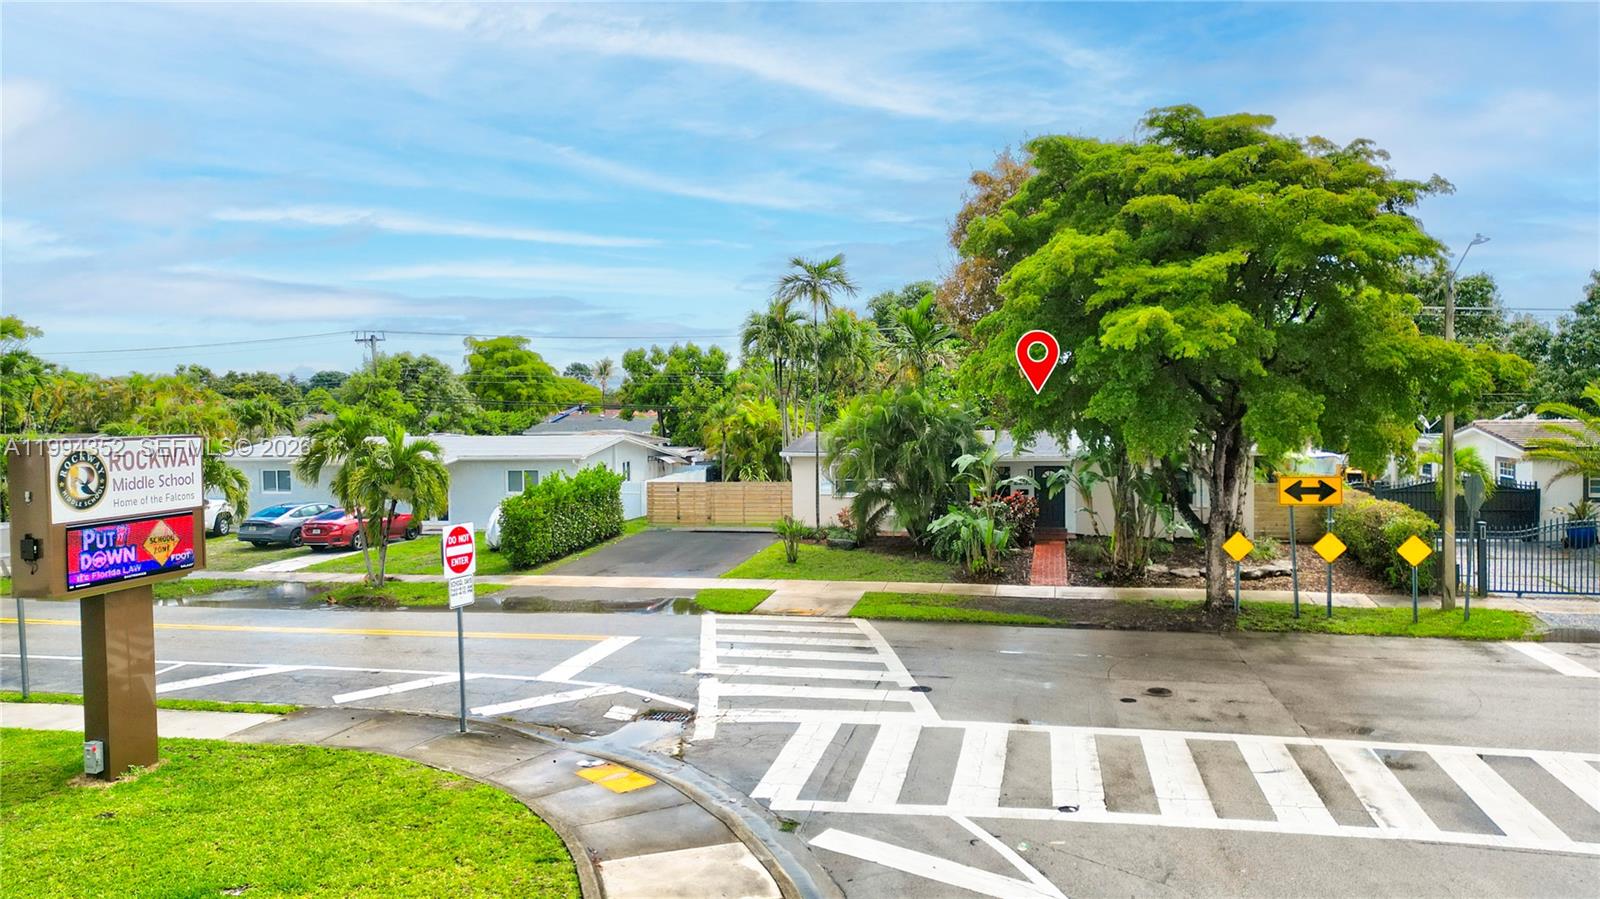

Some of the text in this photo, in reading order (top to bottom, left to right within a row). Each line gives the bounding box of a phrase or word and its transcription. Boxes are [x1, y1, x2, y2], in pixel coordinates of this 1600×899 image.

[60, 451, 105, 477] ROCKWAY
[109, 446, 197, 472] ROCKWAY
[112, 472, 194, 492] Middle School
[62, 486, 105, 507] MIDDLE SCHOOL
[113, 492, 195, 508] Home of the Falcons
[82, 528, 116, 551] PUT
[458, 534, 469, 543] NOT
[80, 546, 136, 570] DOWN
[451, 556, 469, 567] ENTER
[91, 568, 121, 580] Florida
